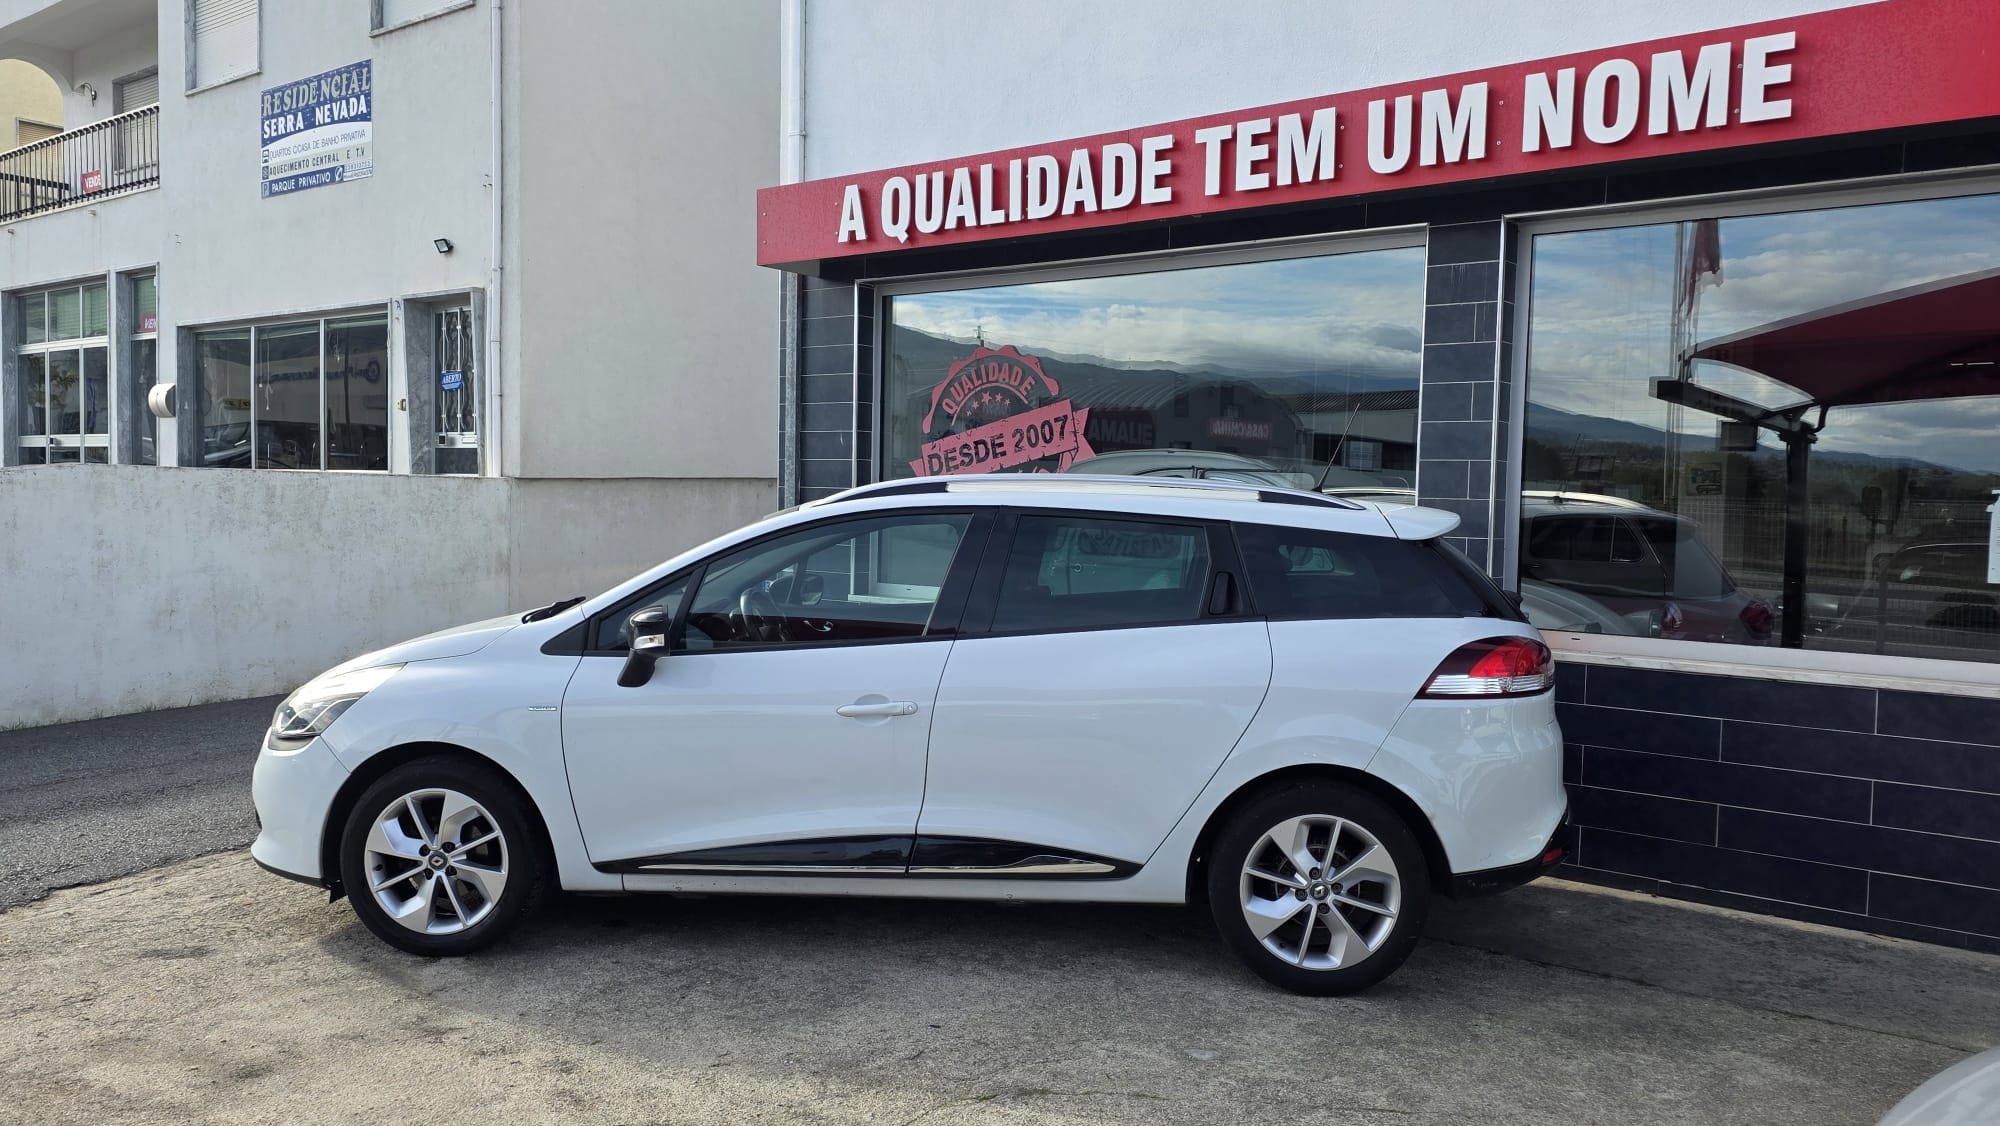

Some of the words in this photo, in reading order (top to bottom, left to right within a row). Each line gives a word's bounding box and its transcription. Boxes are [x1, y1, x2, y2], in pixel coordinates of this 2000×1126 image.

[263, 67, 370, 116] RESIDENCIAL
[263, 112, 304, 139] SERRA
[315, 95, 367, 126] NEVADA
[269, 146, 291, 160] QUARTOS
[313, 139, 320, 149] DE
[321, 135, 339, 147] BANHO
[340, 129, 366, 143] PRIVATIVA
[838, 184, 868, 243] A
[881, 133, 1175, 244] QUALIDADE
[1195, 106, 1337, 196] TEM
[1367, 81, 1488, 175] UM
[1522, 31, 1796, 153] NOME
[269, 158, 309, 175] AQUECIMENTO
[312, 152, 339, 167] CENTRAL
[346, 149, 350, 159] E
[271, 179, 295, 193] PARQUE
[299, 172, 331, 187] PRIVATIVO
[442, 373, 462, 385] ABERTO
[942, 361, 1036, 415] QUALIDADE
[927, 432, 1007, 475] DESDE
[1011, 414, 1069, 452] 2007
[1088, 417, 1152, 446] AMALIE
